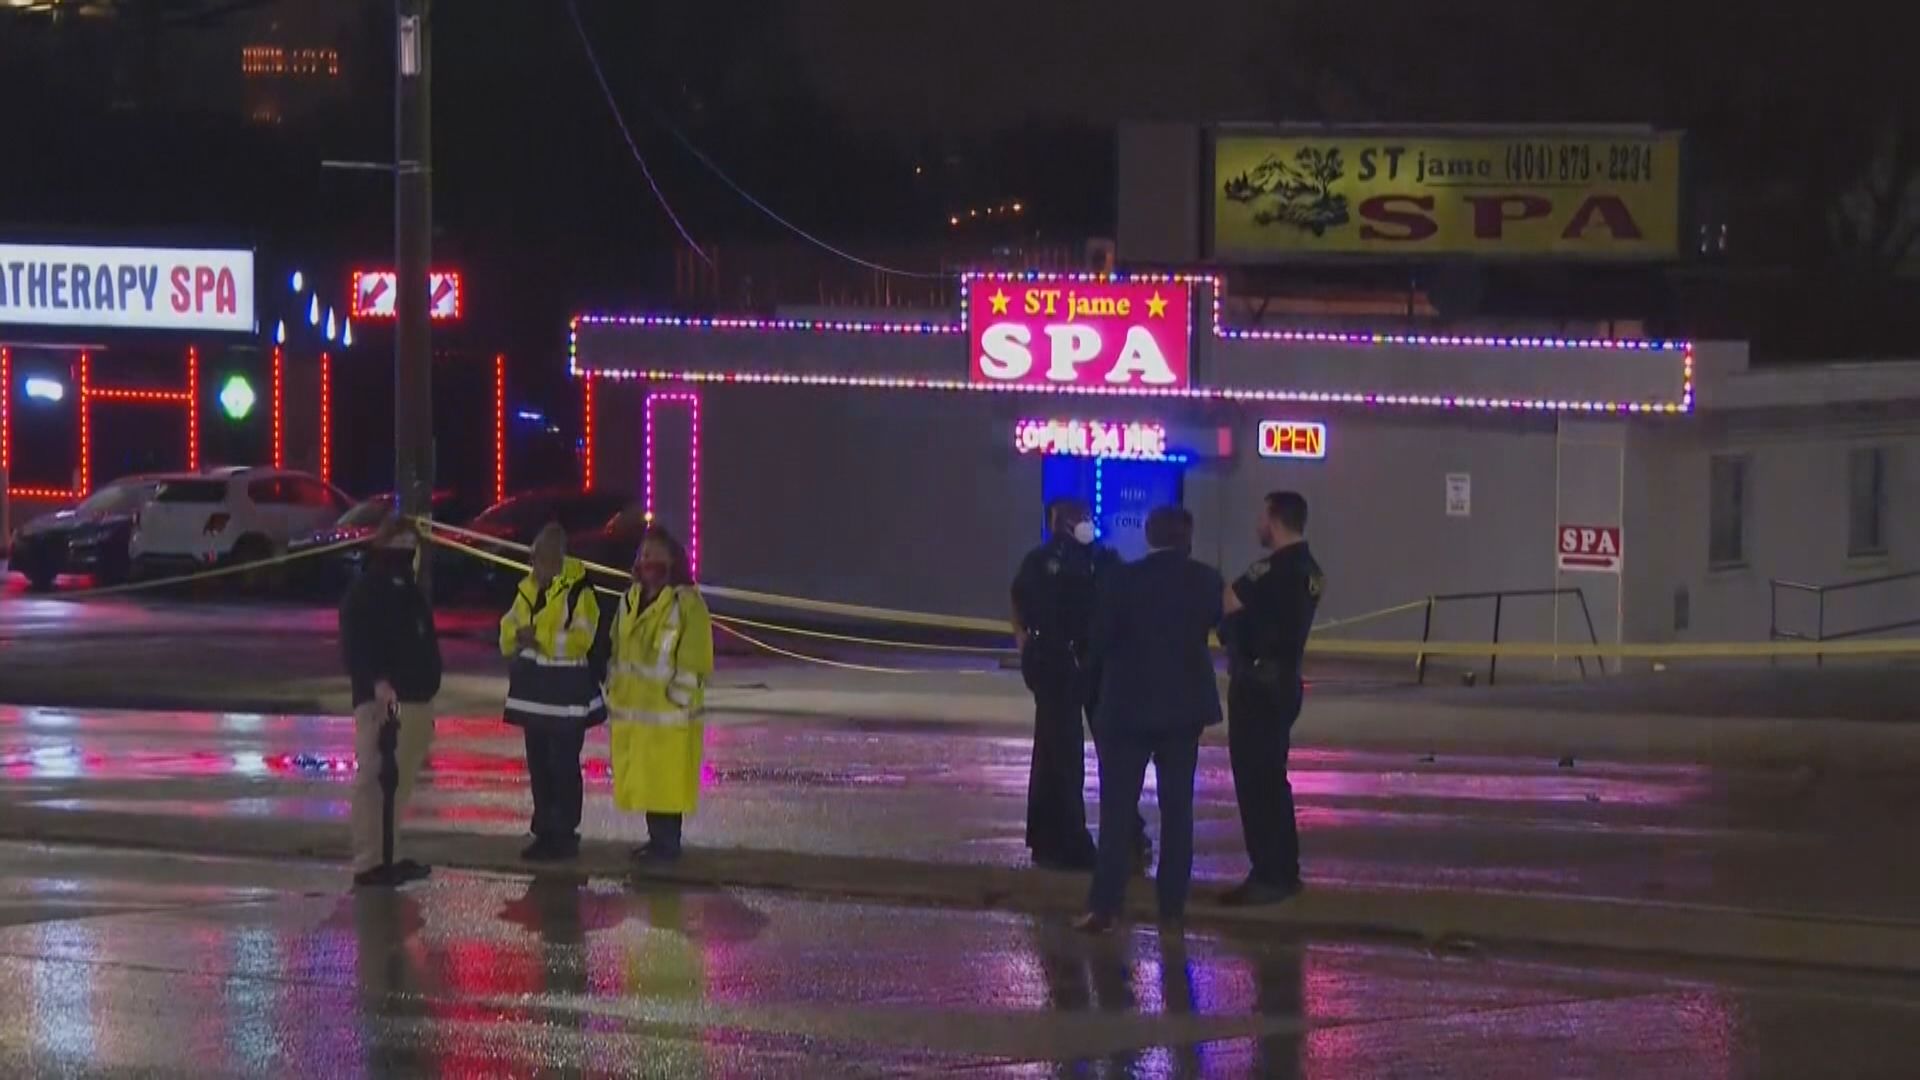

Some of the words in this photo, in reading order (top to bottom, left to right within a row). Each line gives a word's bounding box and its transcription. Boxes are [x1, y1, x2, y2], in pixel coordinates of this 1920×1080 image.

[1358, 147, 1405, 181] ST
[1505, 143, 1552, 181] (404)
[1559, 144, 1590, 181] 873
[1609, 144, 1652, 182] 2234
[1358, 194, 1643, 241] SPA
[170, 265, 237, 315] SPA
[1025, 289, 1060, 314] ST
[1068, 290, 1131, 321] jame
[979, 322, 1176, 384] SPA
[1263, 425, 1321, 453] OPEN
[1562, 528, 1616, 553] SPA
